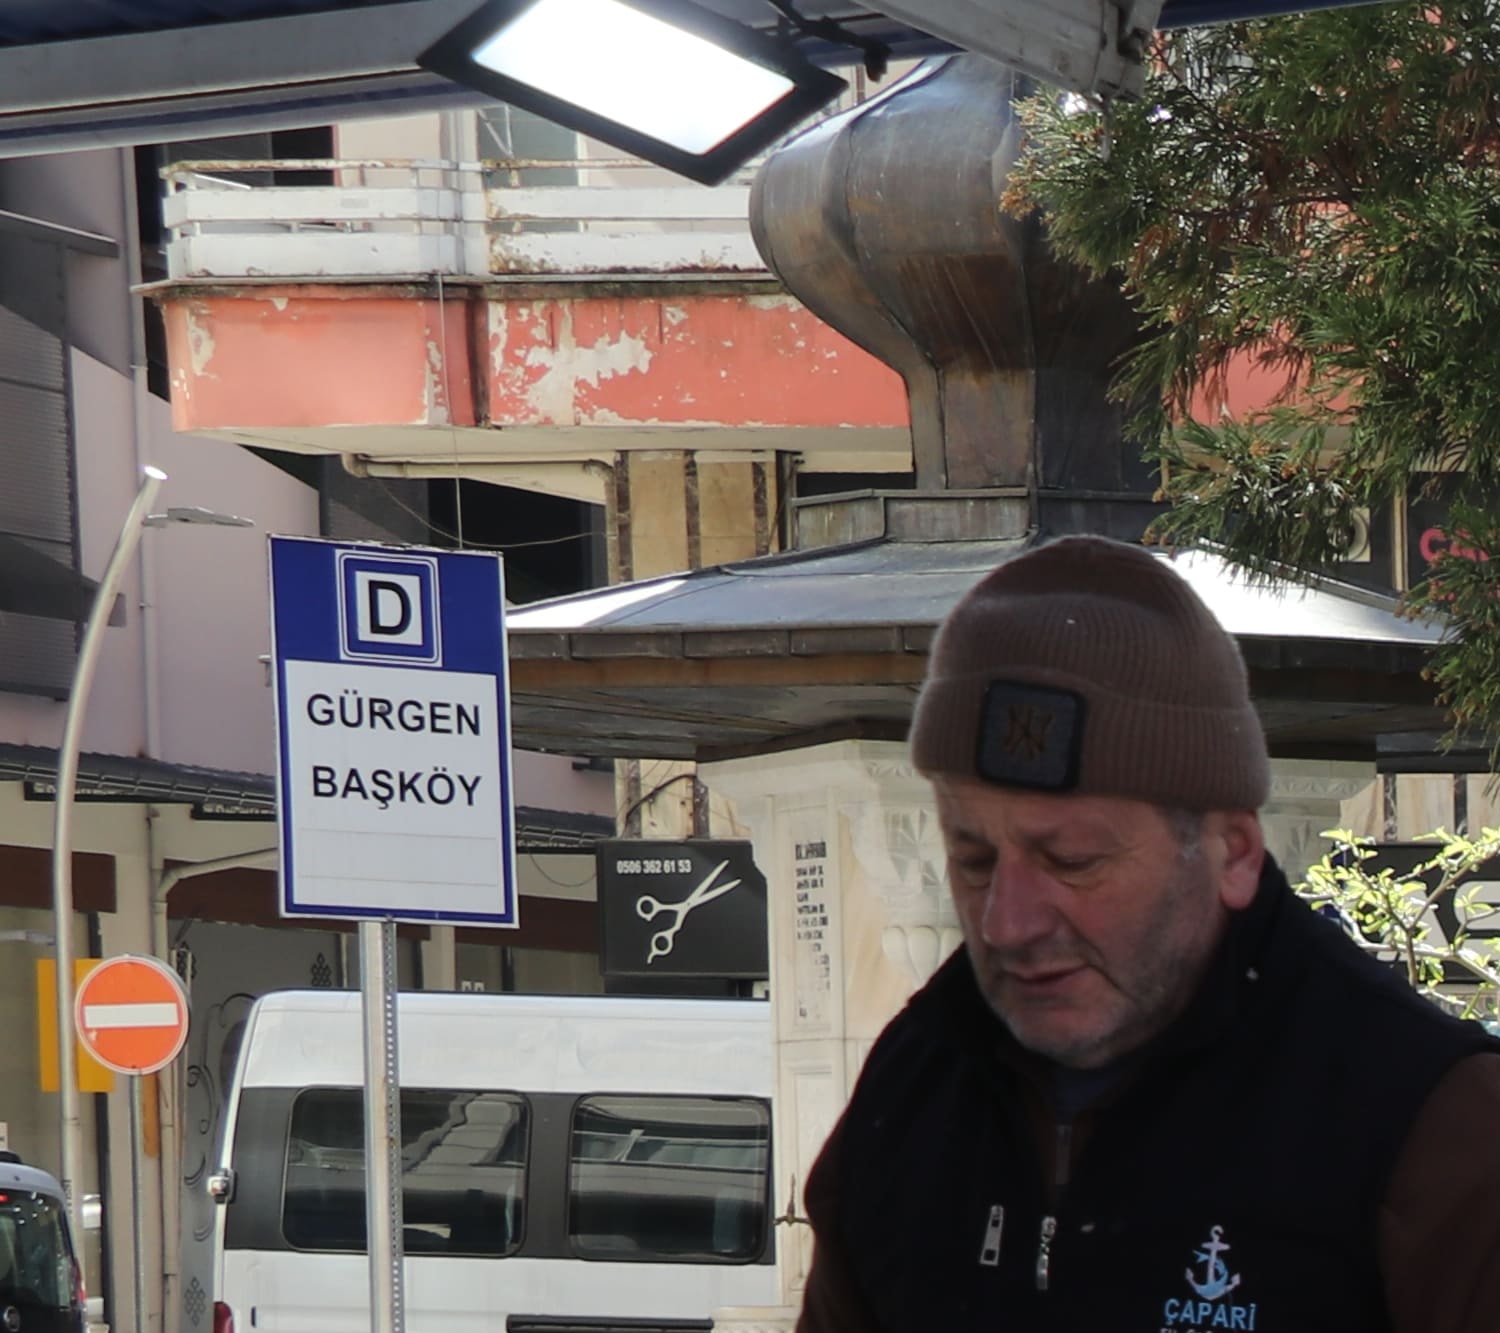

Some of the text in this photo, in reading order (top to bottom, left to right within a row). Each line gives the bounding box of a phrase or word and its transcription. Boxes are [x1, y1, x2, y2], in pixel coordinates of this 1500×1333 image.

[368, 579, 413, 636] D
[306, 689, 480, 737] GÜRGEN
[311, 765, 482, 810] BAŞKÖY
[617, 859, 641, 875] 0506
[664, 859, 676, 874] 61
[678, 859, 692, 874] 53
[1164, 1298, 1256, 1331] ÇAPARİ
